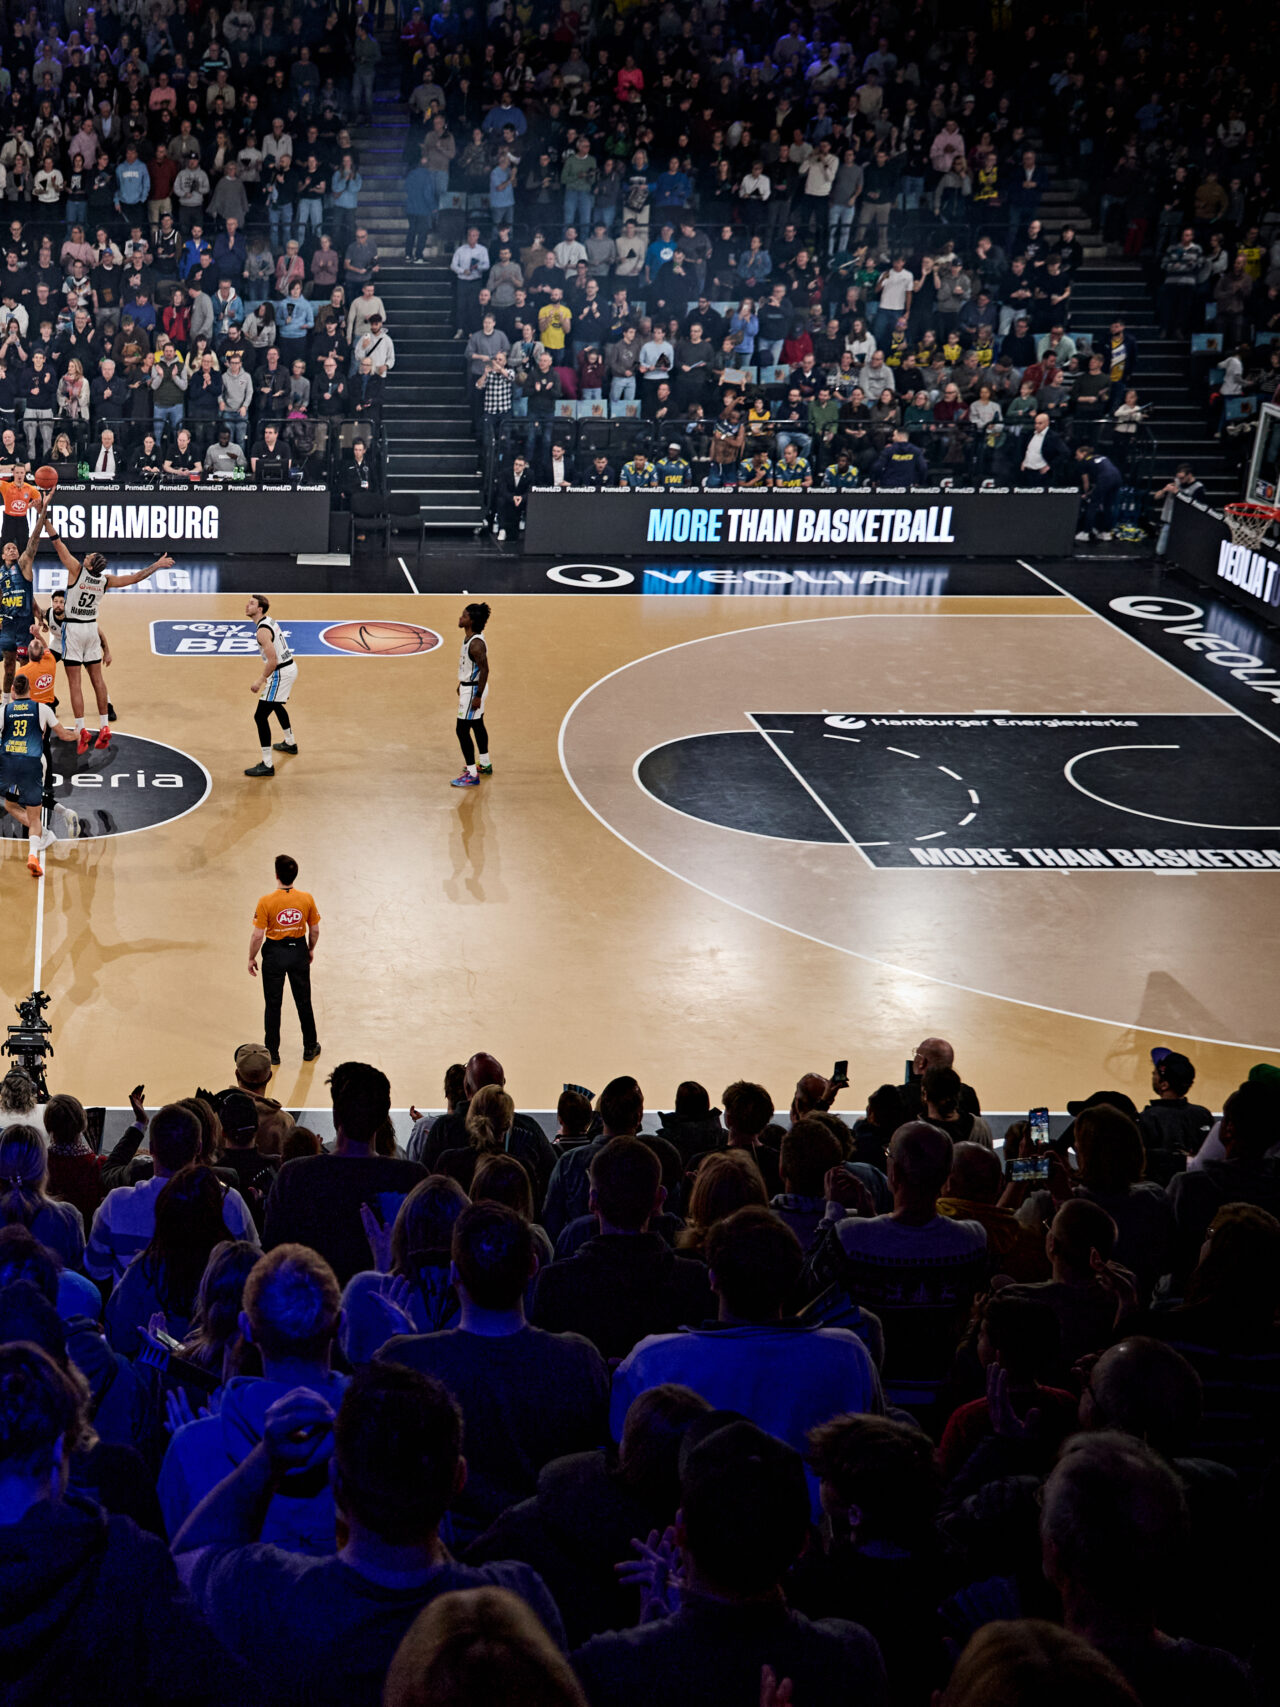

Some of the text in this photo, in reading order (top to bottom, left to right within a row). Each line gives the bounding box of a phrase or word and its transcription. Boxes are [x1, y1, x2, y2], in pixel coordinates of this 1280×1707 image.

[665, 475, 683, 484] EWE
[92, 506, 219, 538] HAMBURG
[647, 506, 955, 543] MORE THAN BASKETBALL
[643, 570, 909, 585] VEOLIA
[1217, 539, 1267, 599] VEOLIA
[78, 592, 96, 608] 52
[13, 720, 28, 737] 33
[871, 718, 1139, 728] Hamburger Energiewerke
[909, 848, 1019, 867] MORE
[1012, 849, 1113, 867] THAN
